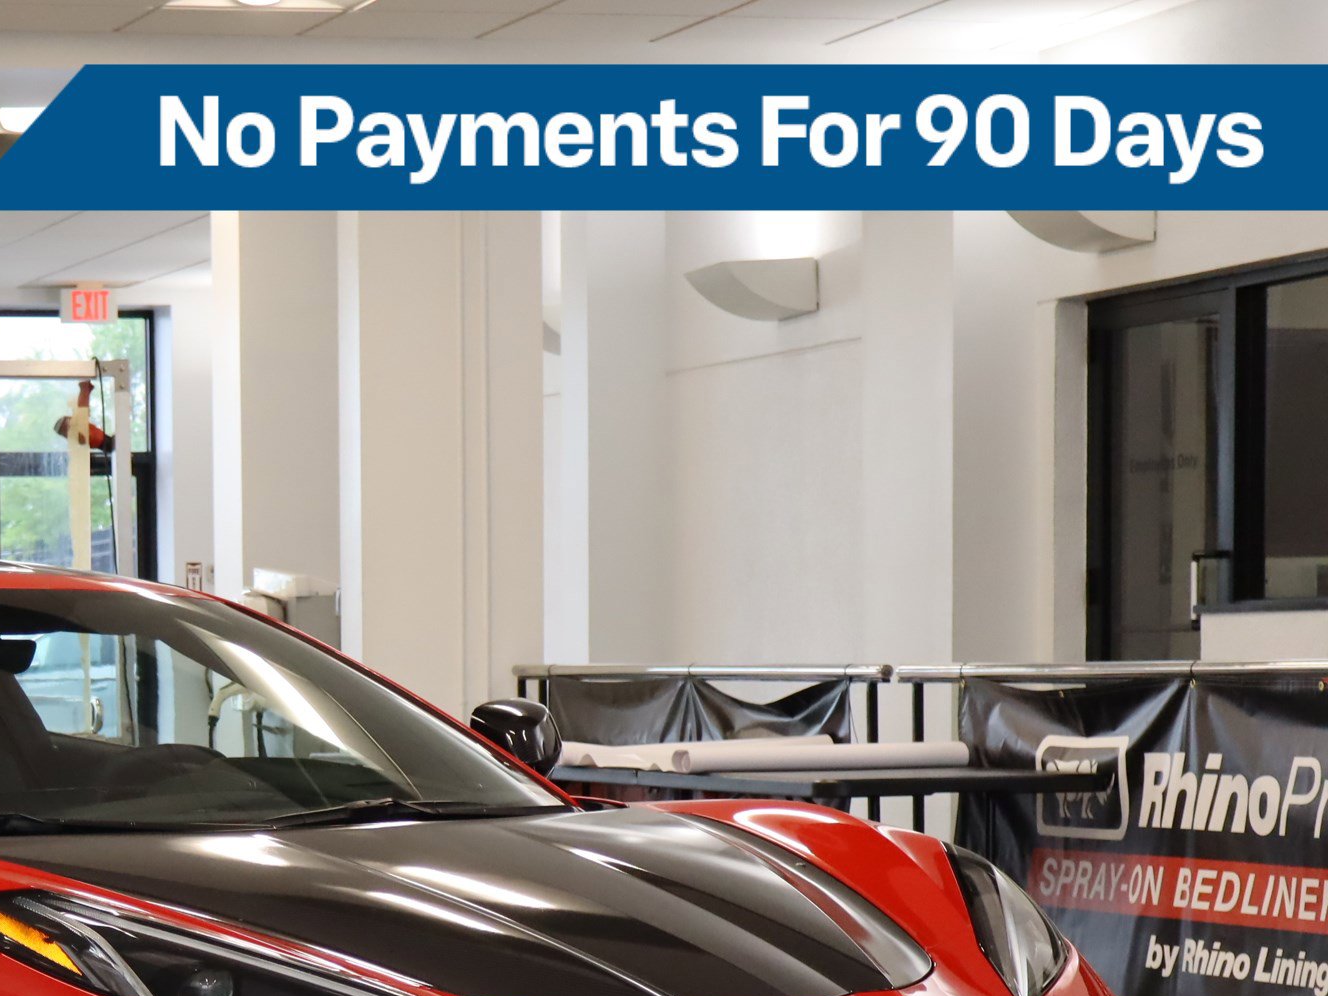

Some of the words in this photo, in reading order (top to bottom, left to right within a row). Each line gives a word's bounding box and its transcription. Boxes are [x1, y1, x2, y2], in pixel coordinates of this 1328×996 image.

[71, 290, 110, 321] EXIT
[1040, 857, 1164, 906] SPRAY-ON
[1145, 934, 1180, 978] by
[1182, 938, 1251, 980] Rhino
